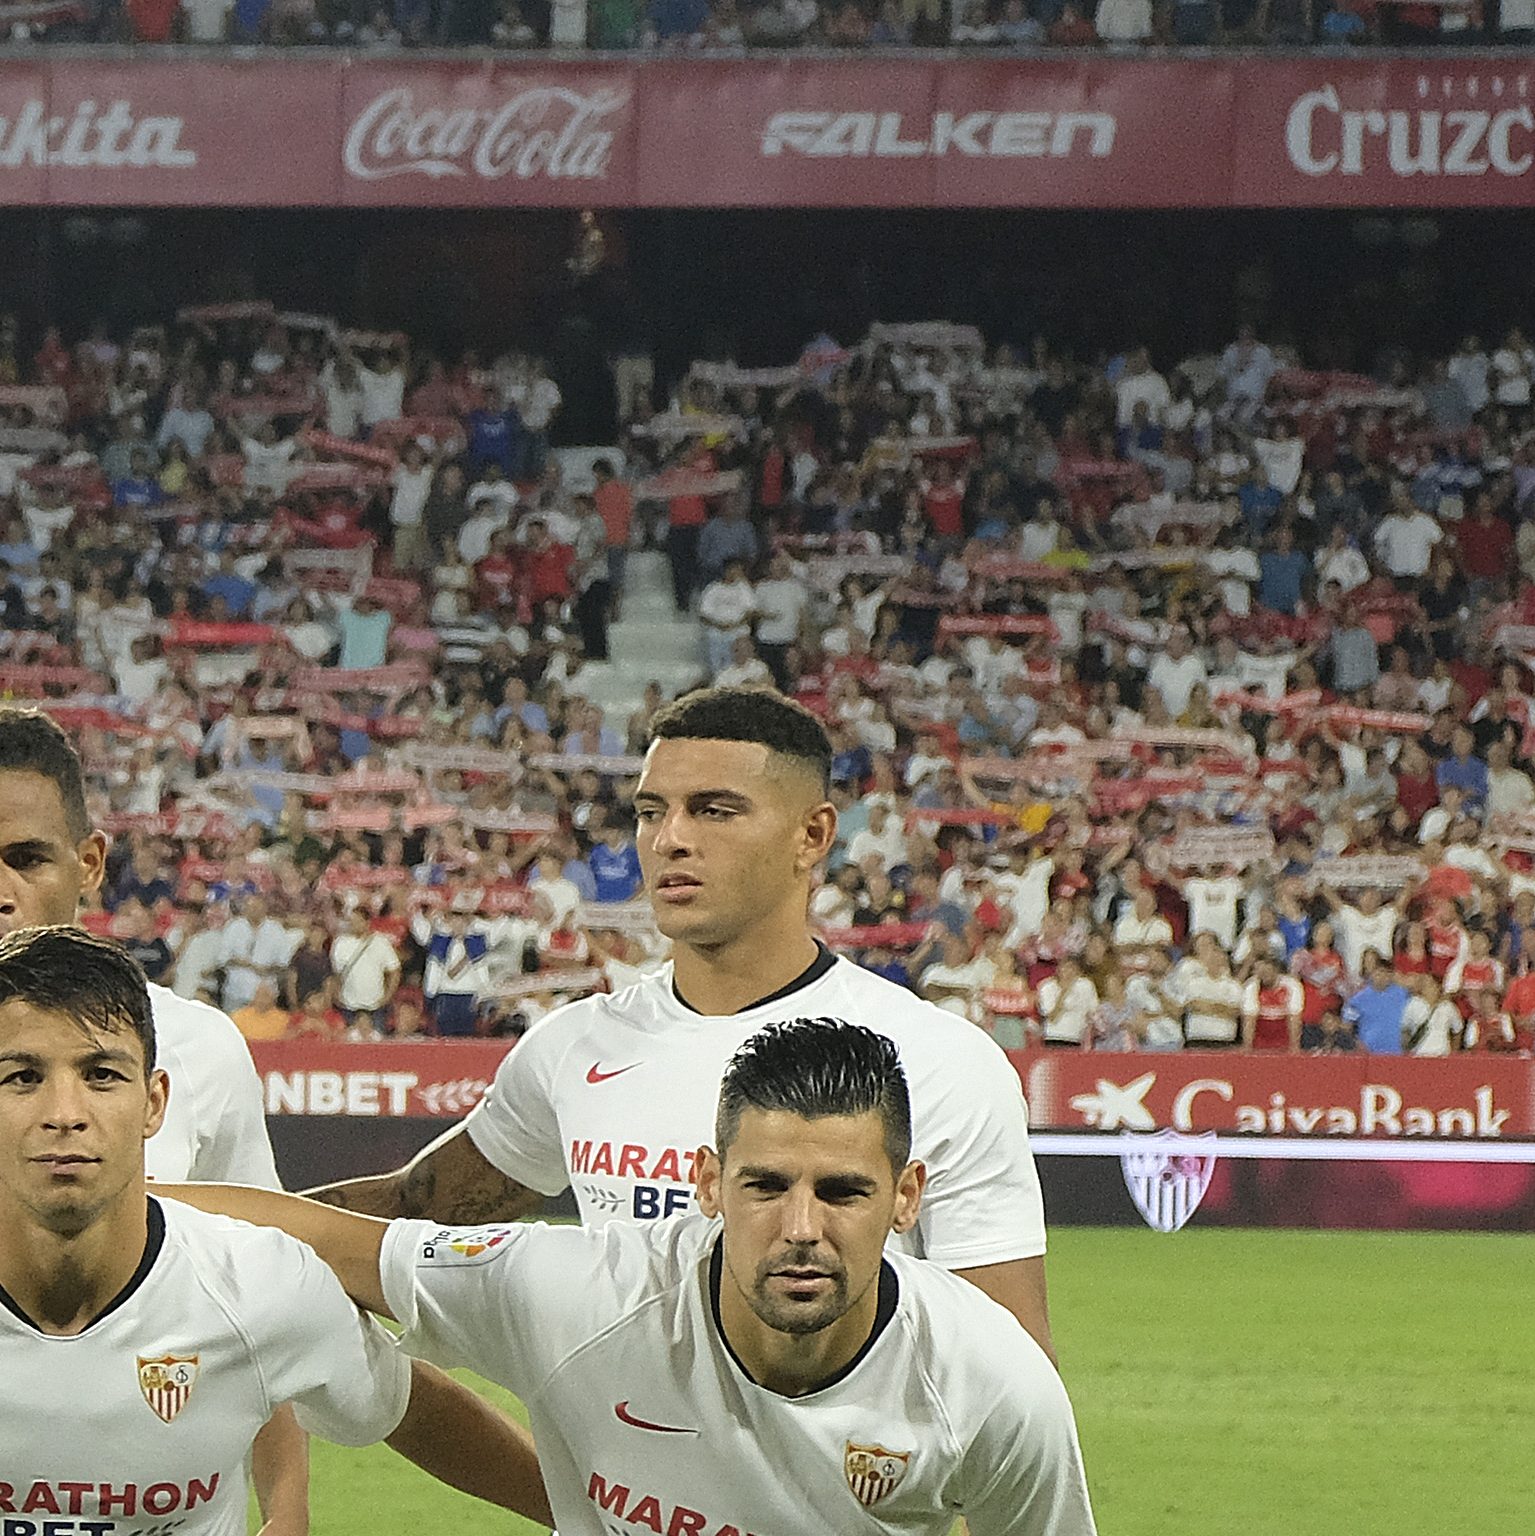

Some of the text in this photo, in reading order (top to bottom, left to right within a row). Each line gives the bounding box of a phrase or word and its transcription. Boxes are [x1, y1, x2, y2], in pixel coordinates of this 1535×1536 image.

[761, 109, 1117, 158] FALKEN
[571, 1139, 696, 1184] MARAT
[633, 1184, 691, 1220] BE
